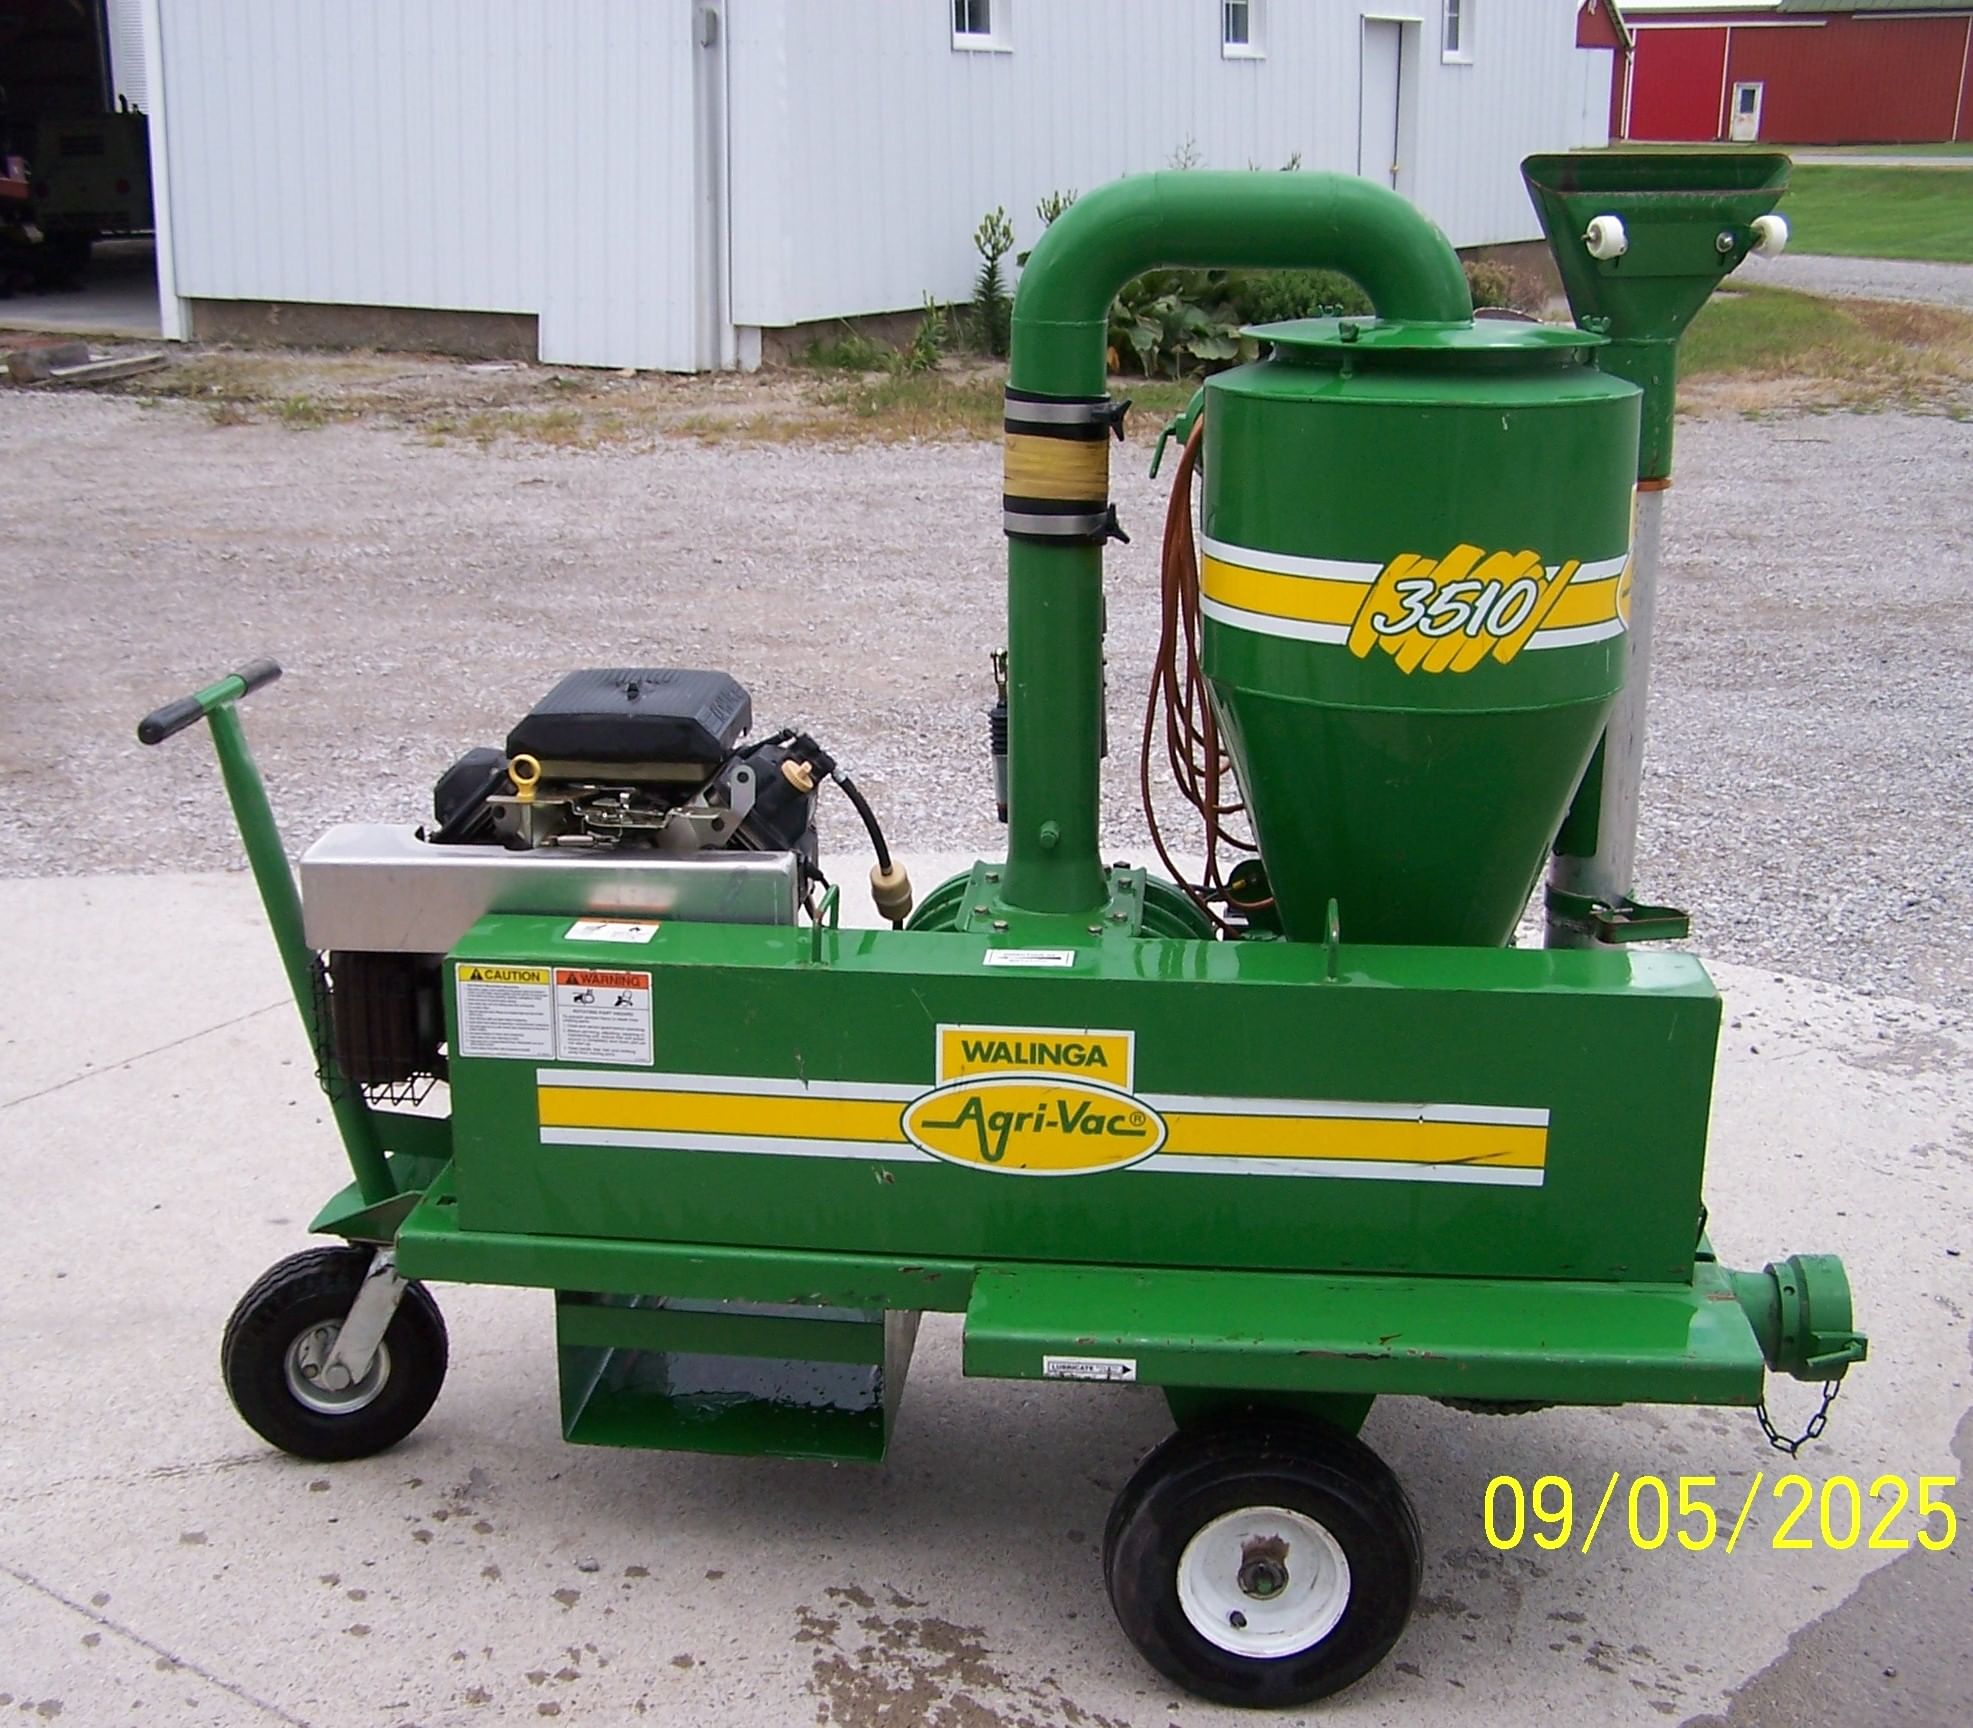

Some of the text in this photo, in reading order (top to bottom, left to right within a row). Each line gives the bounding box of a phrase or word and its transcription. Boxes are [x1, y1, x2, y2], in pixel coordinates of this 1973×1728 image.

[1372, 577, 1539, 636] 3510
[484, 969, 541, 982] CAUTION
[580, 973, 641, 987] WARNING
[961, 1040, 1108, 1067] WALINGA
